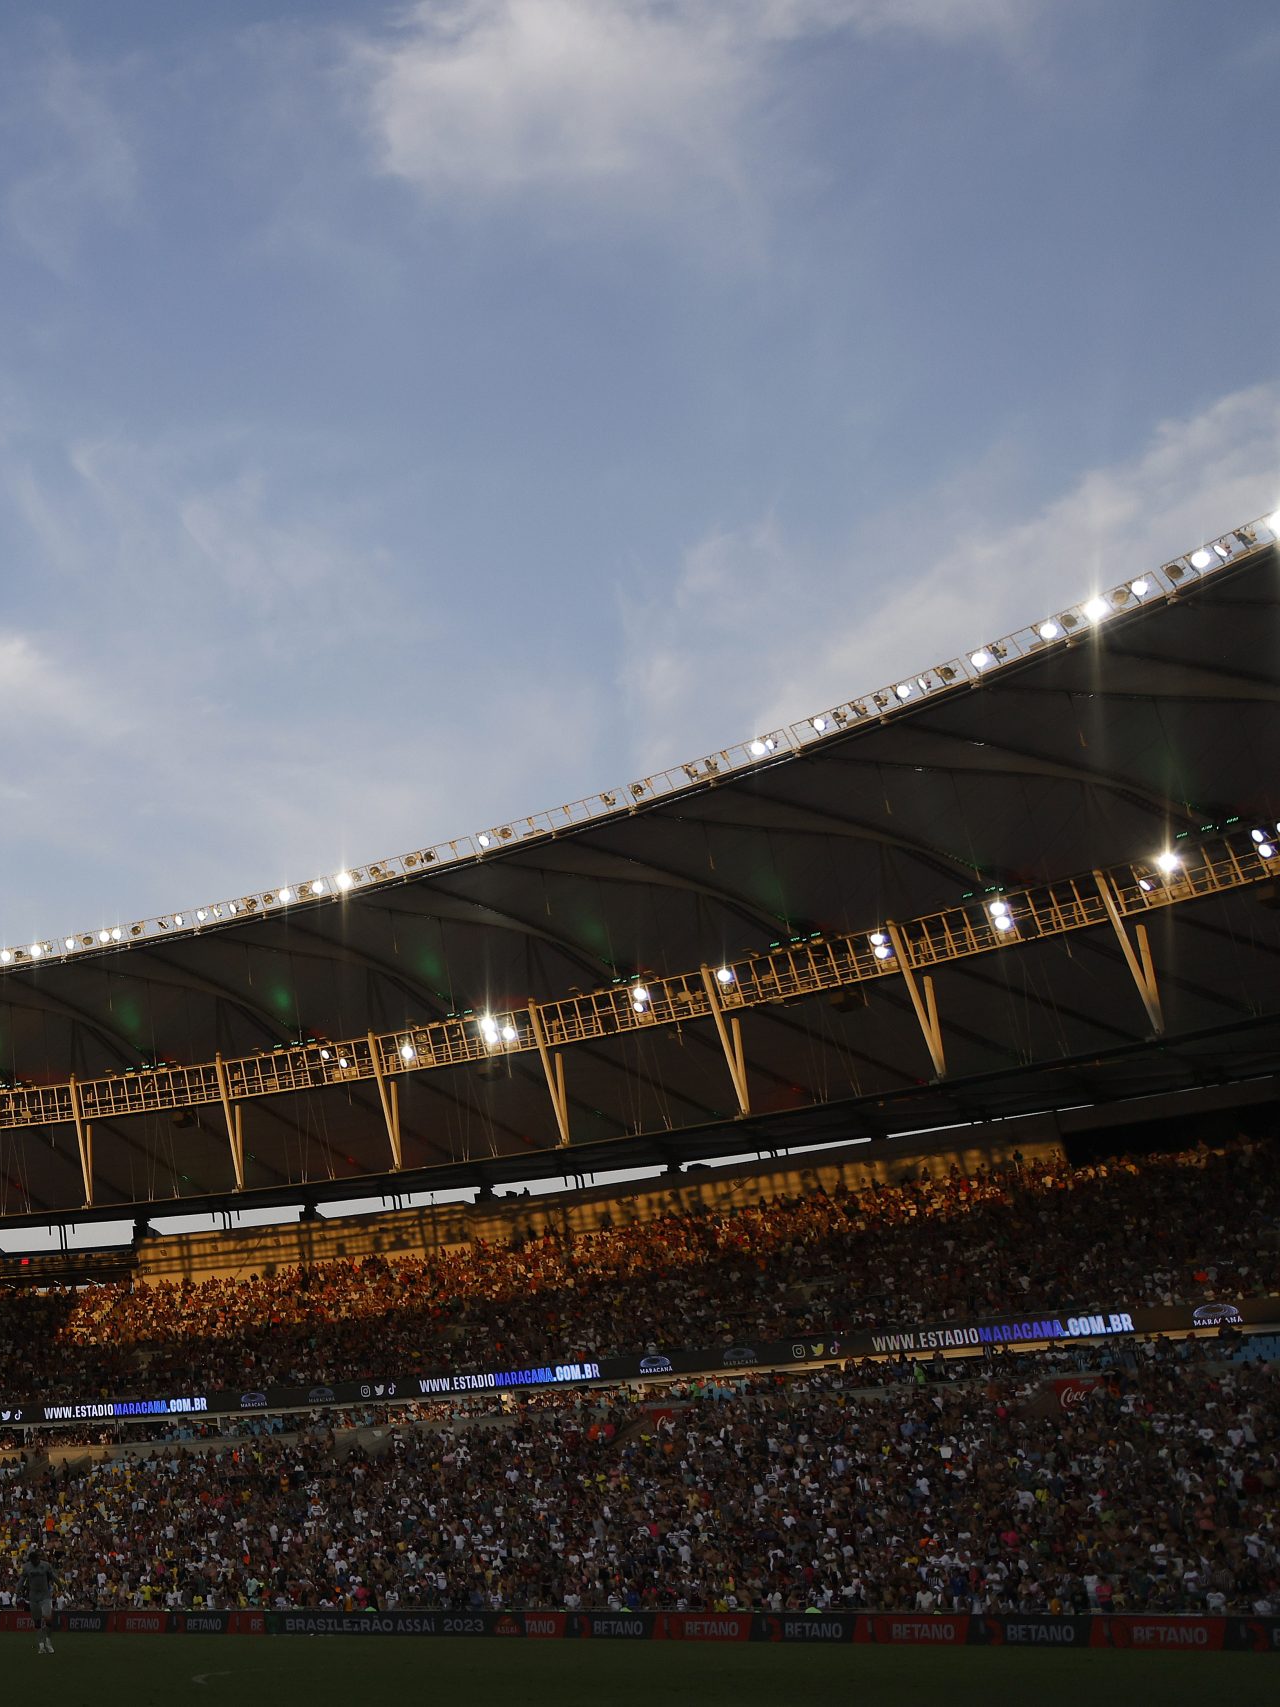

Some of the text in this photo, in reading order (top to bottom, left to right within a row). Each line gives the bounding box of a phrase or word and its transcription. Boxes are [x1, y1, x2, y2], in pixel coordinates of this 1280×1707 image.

[69, 1616, 102, 1630] BETANO
[126, 1617, 160, 1630] BETANO
[187, 1617, 222, 1631] BETANO
[443, 1618, 485, 1633] 2023
[593, 1619, 644, 1636] BETANO
[685, 1621, 739, 1637] BETANO
[784, 1621, 843, 1639] BETANO
[891, 1623, 955, 1641] BETANO
[1006, 1624, 1075, 1642] BETANO
[1132, 1625, 1208, 1645] BETANO
